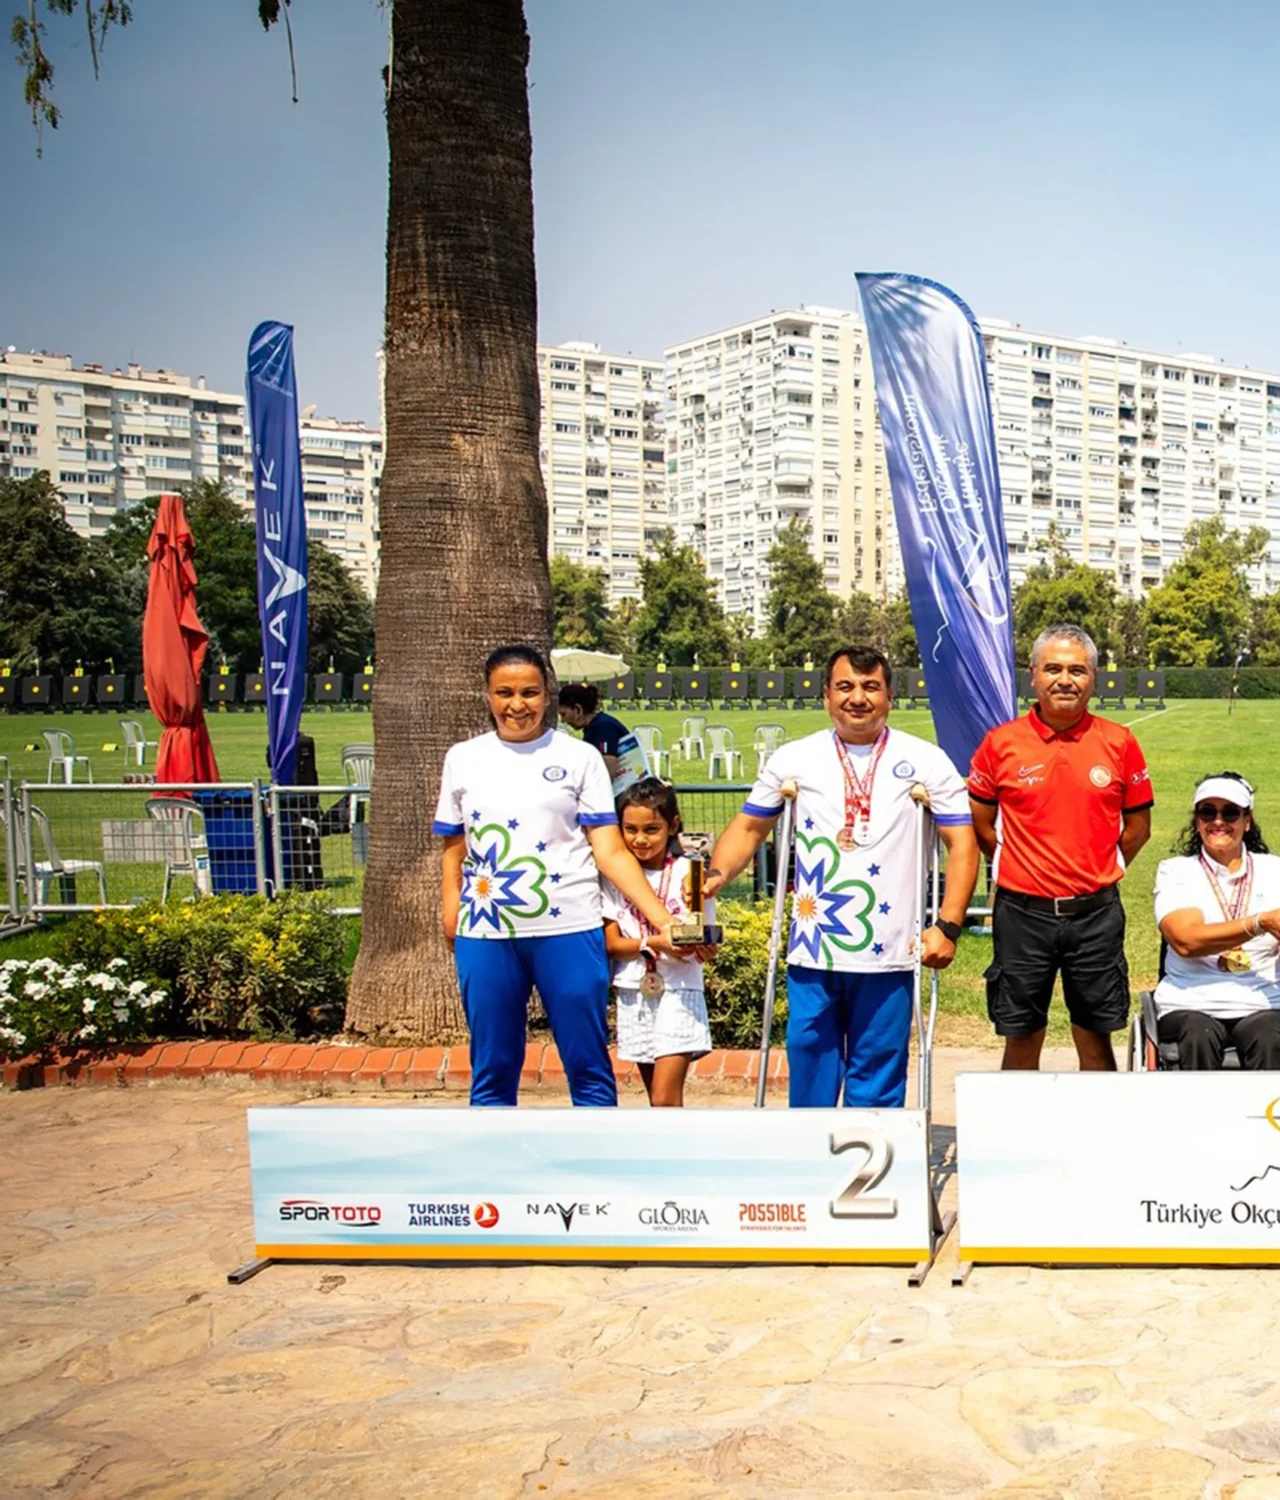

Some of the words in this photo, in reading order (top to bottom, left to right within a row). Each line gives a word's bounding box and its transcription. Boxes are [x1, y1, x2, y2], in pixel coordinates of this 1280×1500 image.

[260, 458, 307, 696] NAVEK
[829, 1126, 898, 1219] 2
[408, 1203, 470, 1214] TURKISH
[408, 1215, 471, 1227] AIRLINES
[527, 1202, 609, 1232] NAVEK
[638, 1203, 710, 1225] GLORIA
[1141, 1200, 1222, 1228] Türkiye
